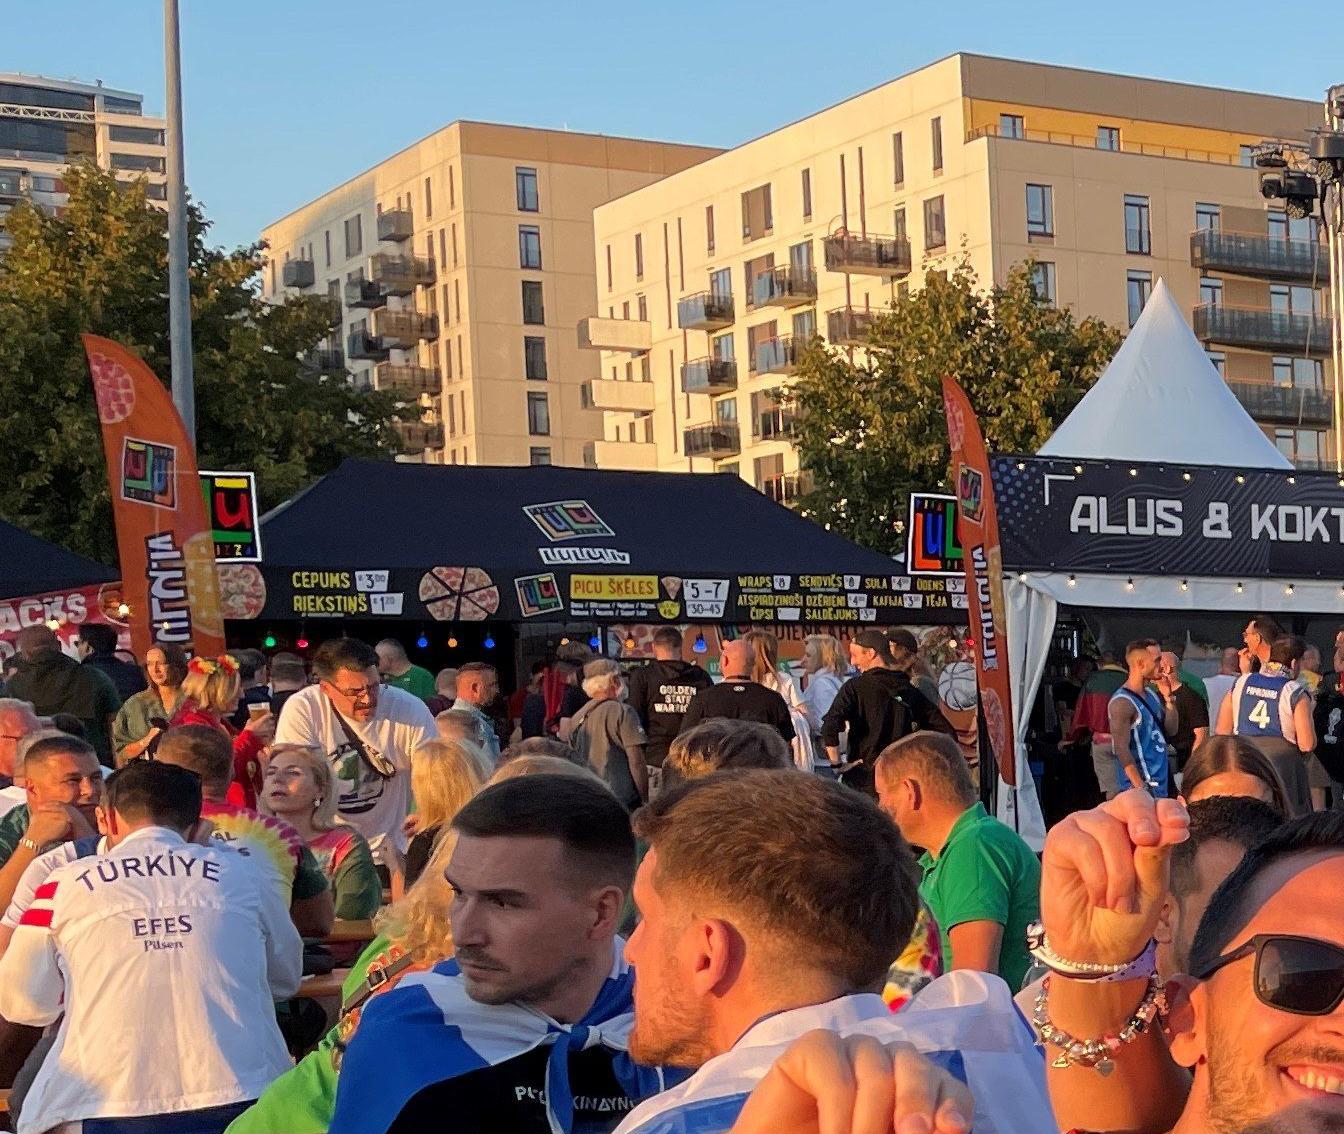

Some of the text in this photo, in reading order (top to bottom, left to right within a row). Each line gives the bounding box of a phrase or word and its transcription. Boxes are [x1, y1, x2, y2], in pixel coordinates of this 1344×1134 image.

[1070, 496, 1183, 537] ALUS
[1203, 502, 1232, 539] &
[292, 571, 350, 590] CEPUMS
[574, 580, 603, 595] PICU
[608, 577, 655, 598] ŠĶĒLES
[737, 575, 772, 589] WRAPS
[0, 593, 88, 633] ACKS
[293, 592, 368, 616] RIEKSTIŅŠ
[750, 606, 774, 621] ČIPSI
[659, 684, 697, 696] GOLDEN
[1248, 699, 1271, 729] 4
[75, 849, 223, 892] TÜRKİYE
[132, 914, 194, 939] EFES
[143, 938, 184, 953] Pilsen
